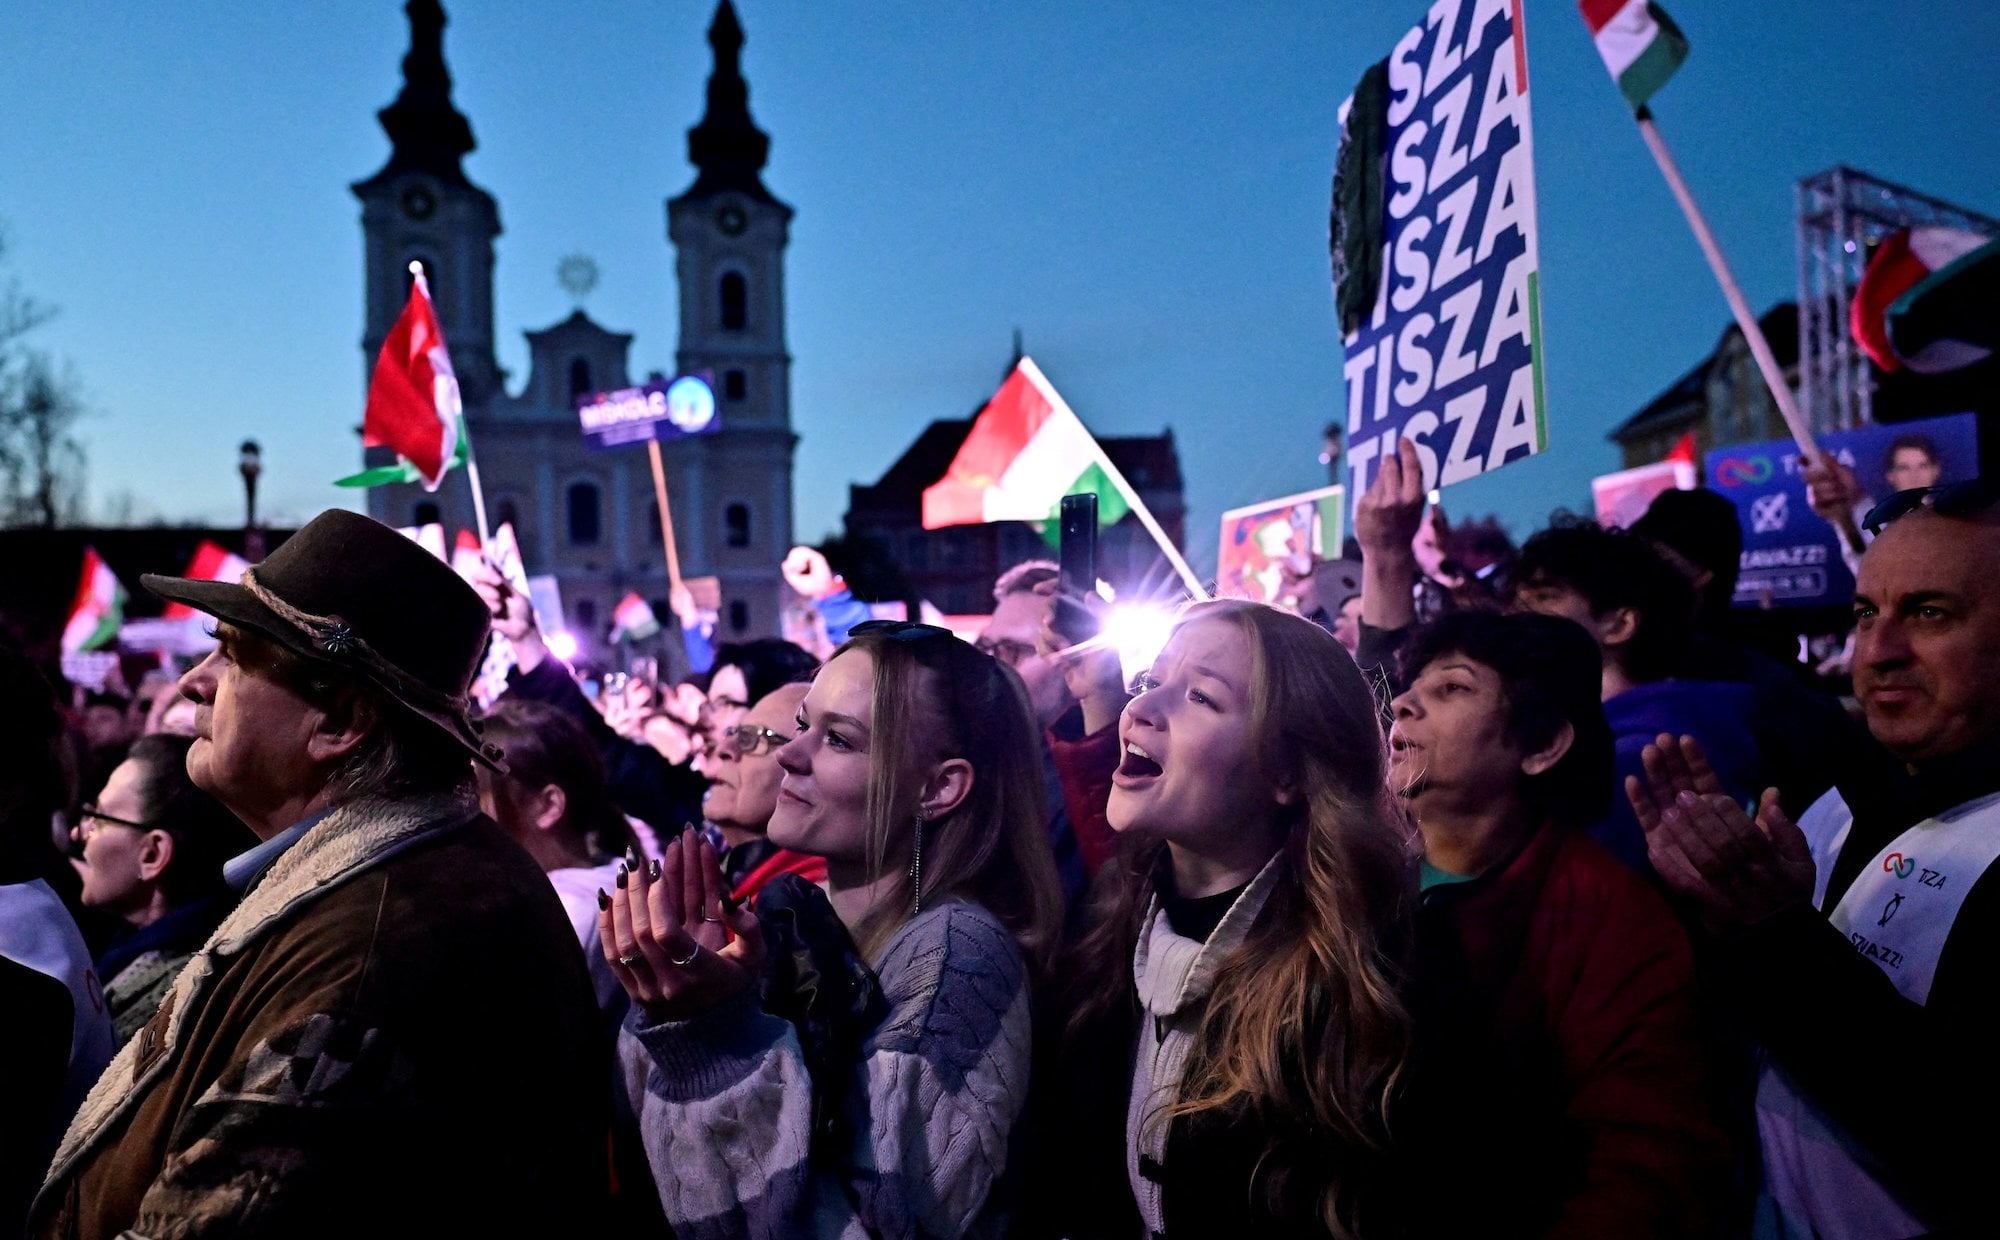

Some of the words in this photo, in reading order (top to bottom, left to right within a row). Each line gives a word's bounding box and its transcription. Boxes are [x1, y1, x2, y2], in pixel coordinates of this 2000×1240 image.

[1388, 35, 1519, 219] SZA
[1371, 142, 1526, 331] ISZA
[1344, 252, 1533, 435] TISZA
